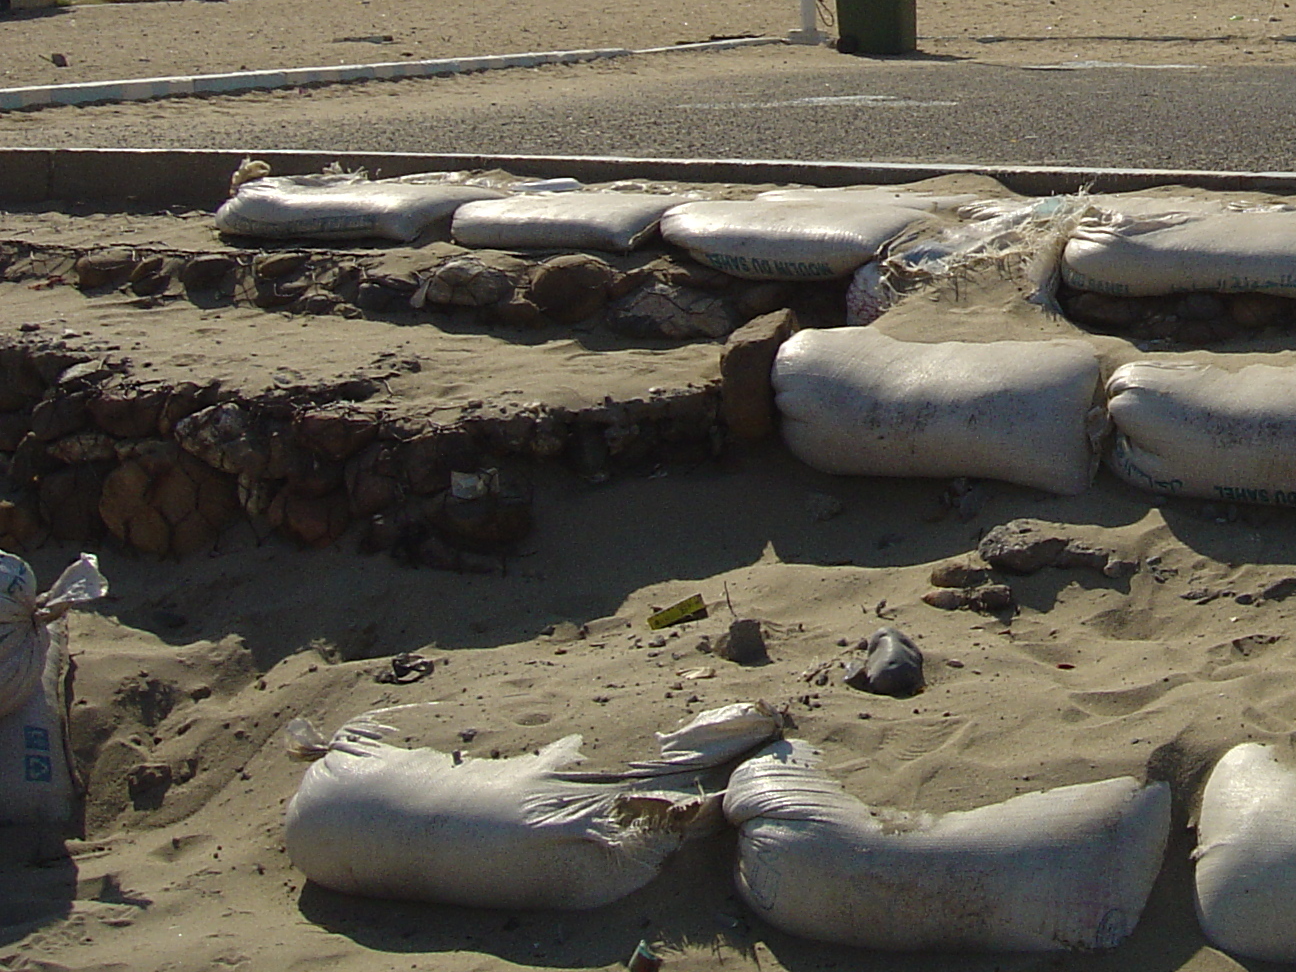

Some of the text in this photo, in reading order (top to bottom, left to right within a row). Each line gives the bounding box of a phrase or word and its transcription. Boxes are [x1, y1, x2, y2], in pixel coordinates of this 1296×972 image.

[705, 254, 834, 276] MOULIN DU SAHEL
[1213, 485, 1269, 503] SAHEL
